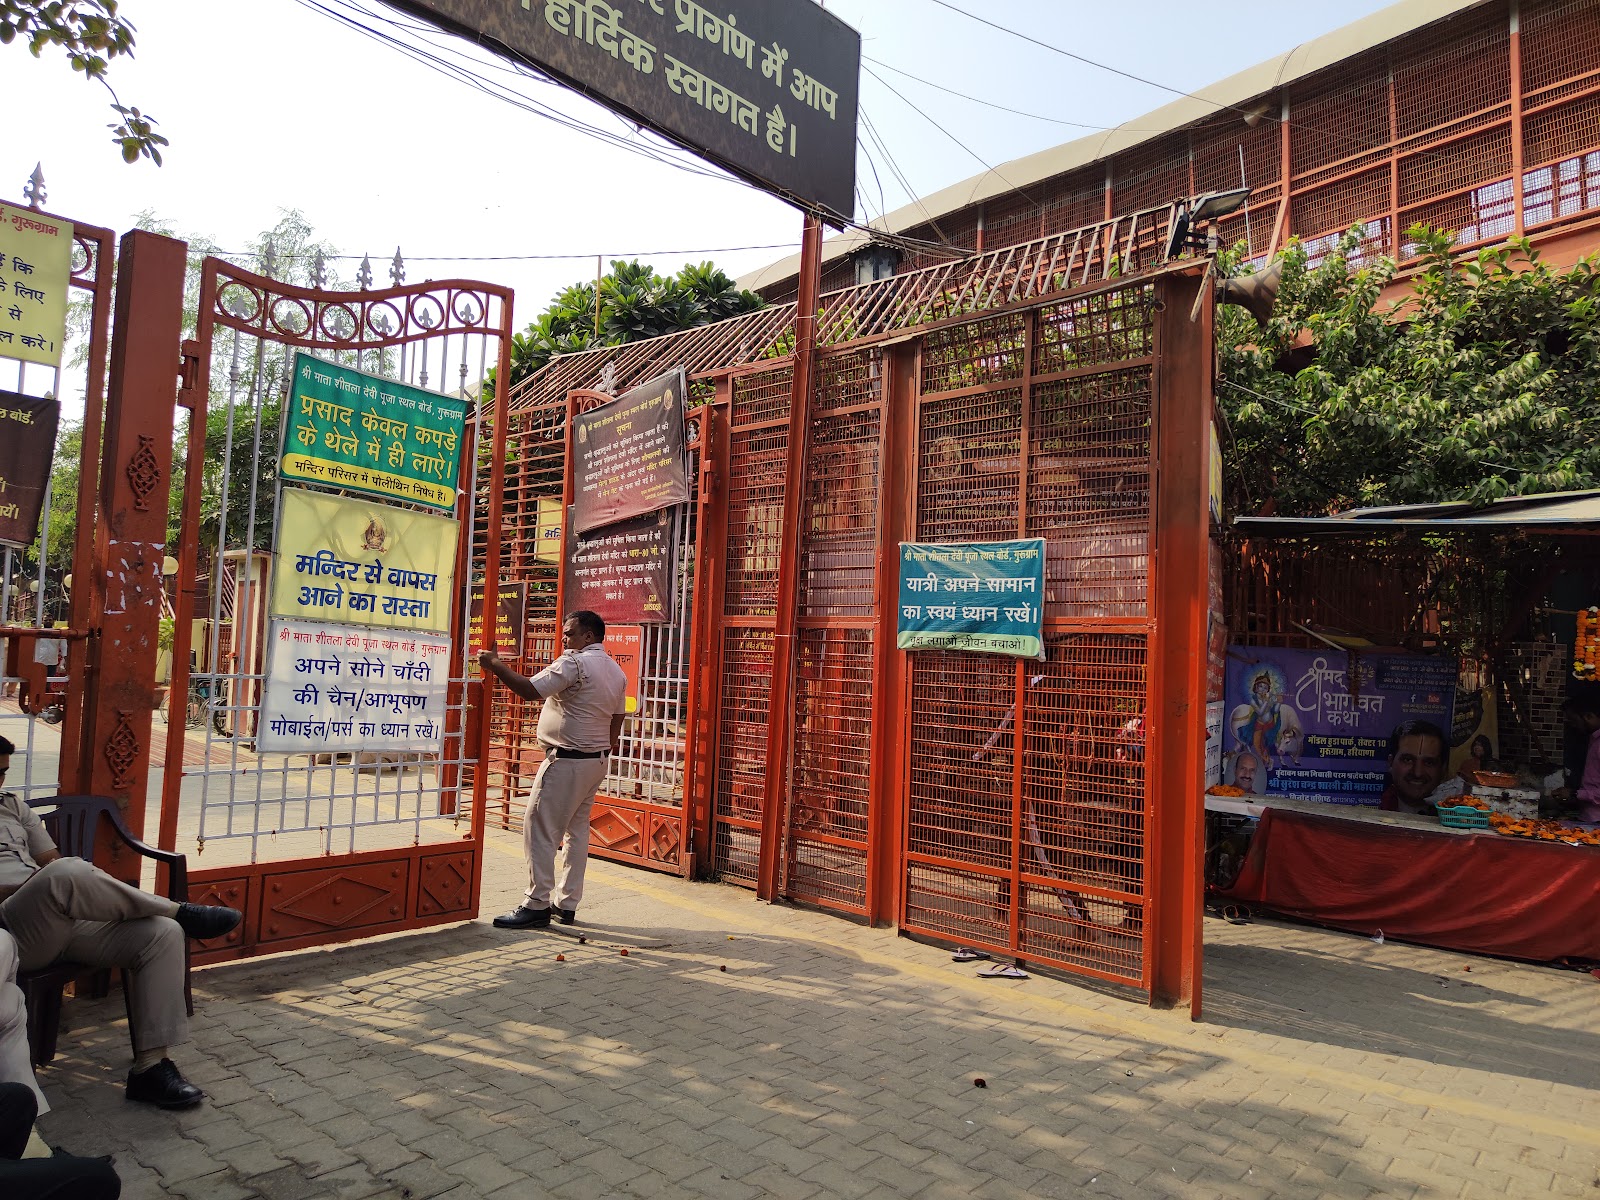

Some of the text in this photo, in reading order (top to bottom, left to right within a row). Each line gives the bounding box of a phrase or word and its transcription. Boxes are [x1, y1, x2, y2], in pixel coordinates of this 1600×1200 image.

[675, 0, 838, 121] प्रागंण में आप
[544, 0, 797, 158] हार्दिक स्वागत है।
[13, 256, 35, 276] कि
[14, 281, 46, 305] लिए
[8, 304, 23, 322] से
[302, 365, 311, 380] श्री
[314, 371, 331, 387] माता
[334, 375, 361, 395] शीतला
[363, 384, 378, 399] देवी
[380, 389, 396, 406] पूजा
[398, 396, 416, 410] स्थल
[9, 408, 35, 426] बोर्ड,
[300, 394, 459, 456] प्रसाद केवल कपड़े
[296, 420, 318, 447] के
[324, 426, 360, 457] थेले
[365, 435, 382, 462] में
[387, 440, 406, 468] ही
[295, 460, 325, 475] मन्दिर
[328, 466, 358, 482] परिसर
[361, 470, 370, 484] में
[371, 474, 410, 494] पोलीथिन
[412, 482, 435, 499] निषेध
[904, 550, 912, 562] श्री
[913, 552, 927, 563] माता
[928, 549, 949, 562] शीतला
[950, 549, 963, 562] देवी
[964, 551, 979, 565] पूजा
[980, 550, 995, 562] स्थल
[295, 549, 438, 592] मन्दिर से वापस
[905, 571, 1037, 593] यात्री अपने सामान
[297, 582, 431, 619] आने का रास्ता
[902, 601, 1038, 624] का स्वयं ध्यान रखें।
[279, 627, 290, 642] श्री
[293, 630, 312, 644] माता
[315, 630, 342, 646] शीतला
[345, 634, 360, 648] देवी
[362, 637, 378, 652] पूजा
[381, 639, 399, 651] स्थल
[294, 654, 431, 682] अपने सोने चाँदी
[292, 683, 428, 714] की चैन/आभूषण
[269, 714, 440, 742] मोबाईल/पर्स का ध्यान रखें।
[1326, 709, 1361, 728] कथा
[1377, 739, 1387, 749] 10
[1268, 777, 1280, 789] श्री
[1280, 778, 1301, 791] सुरेश
[1341, 780, 1353, 791] जी
[1353, 782, 1385, 792] महाराज
[1333, 771, 1347, 780] परम
